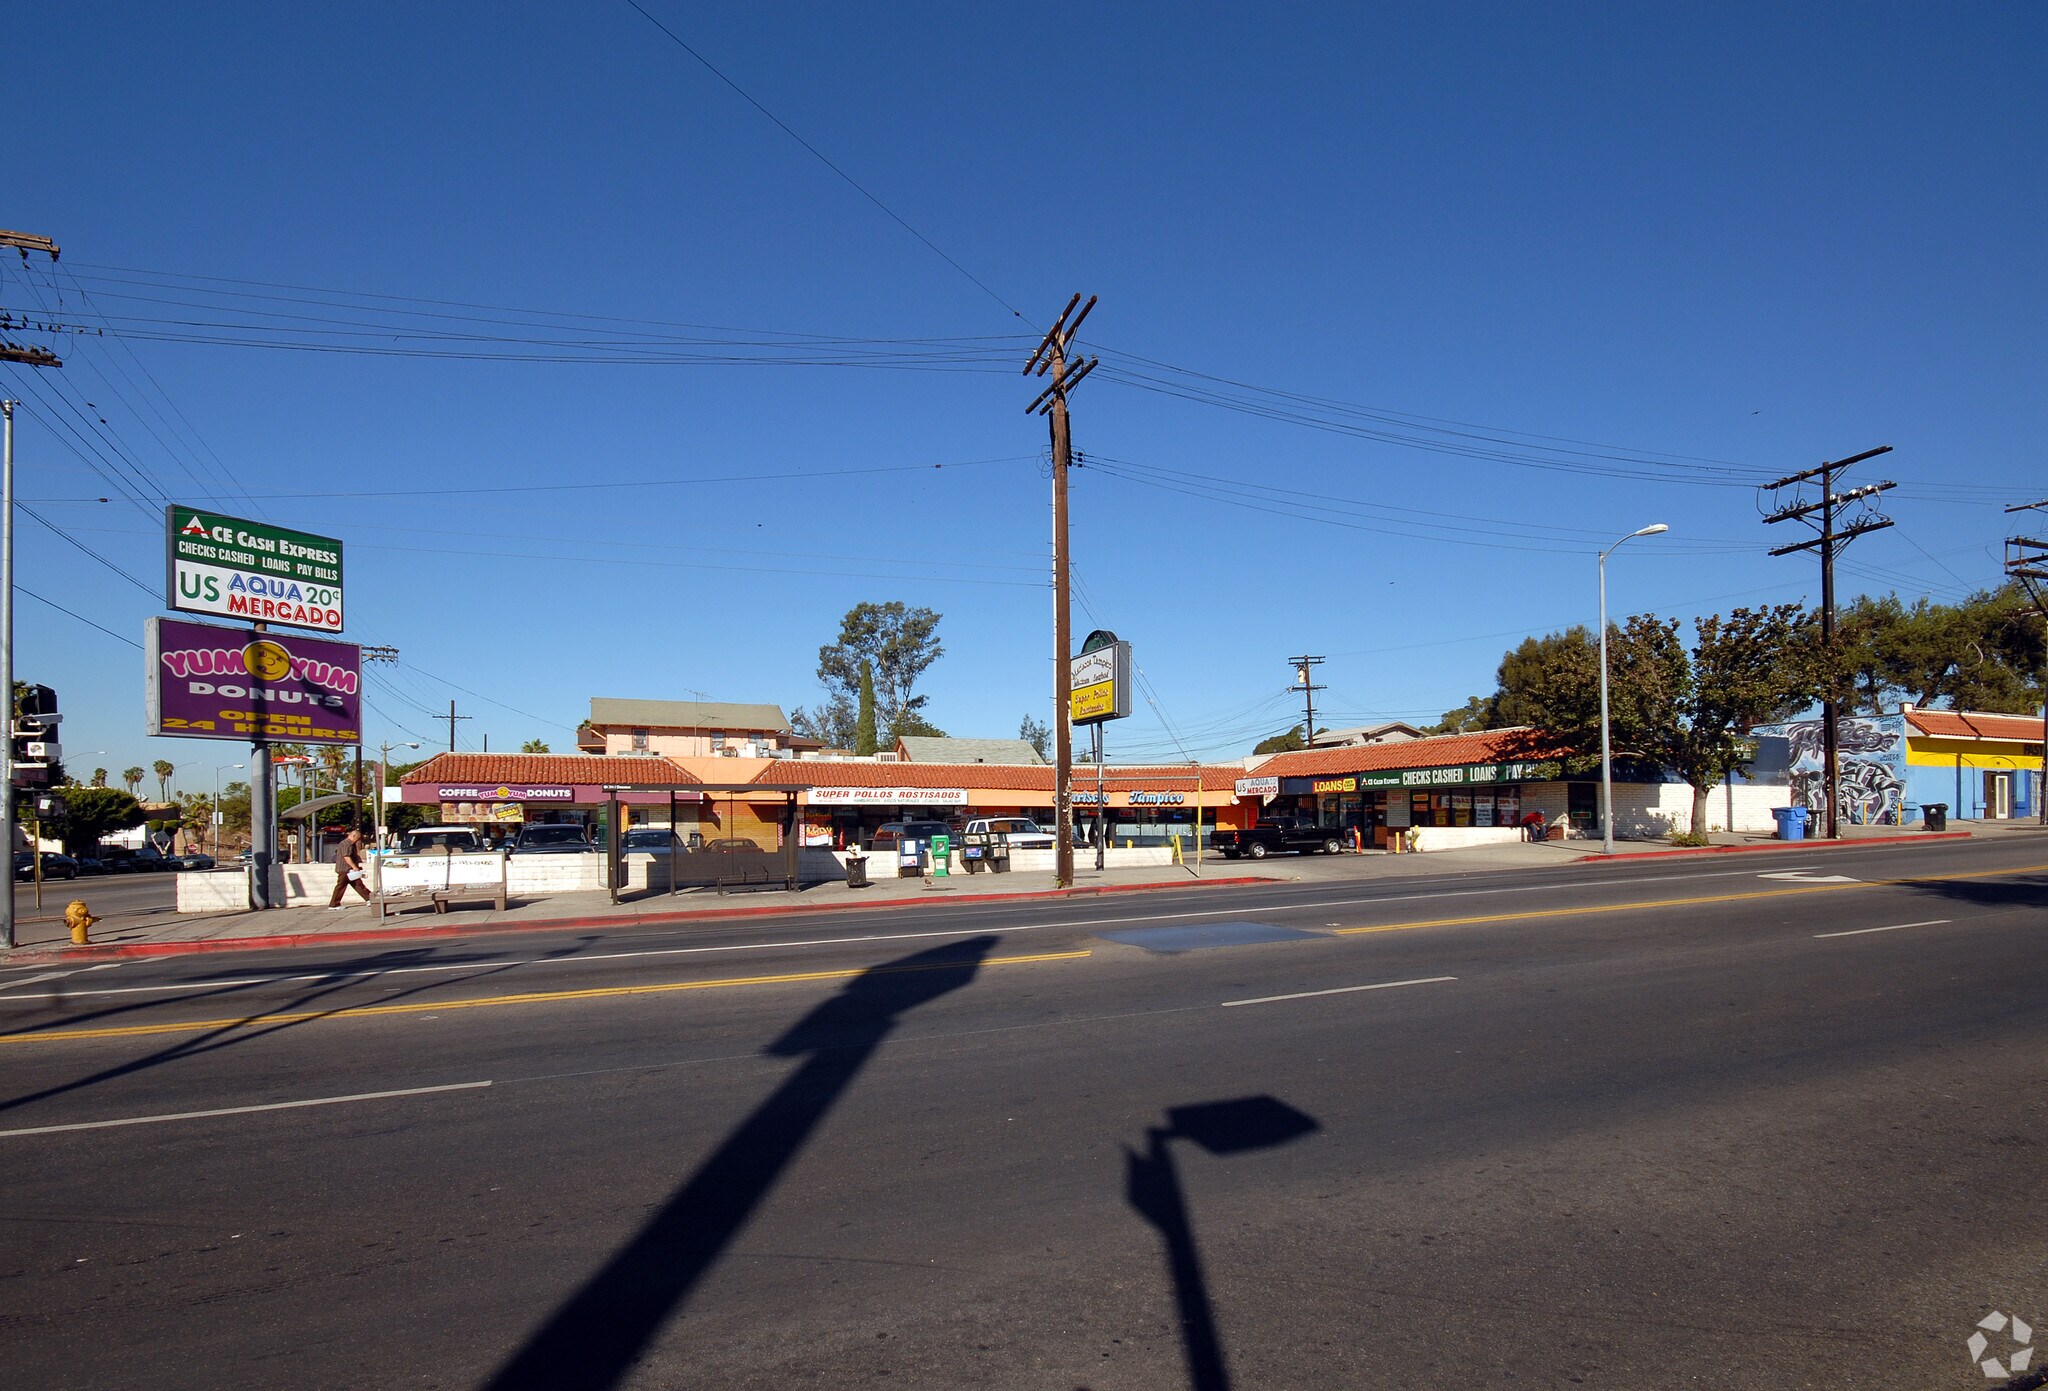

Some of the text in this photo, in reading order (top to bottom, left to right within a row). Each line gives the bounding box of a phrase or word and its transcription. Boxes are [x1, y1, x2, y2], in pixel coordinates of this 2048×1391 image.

[181, 515, 337, 564] ACE CASH EXPRESS
[179, 540, 338, 581] CHECKS CASHED LOANS PAY BILLS
[180, 571, 220, 602] US
[227, 573, 303, 602] AQUA
[227, 594, 341, 627] MERCADO
[161, 649, 358, 694] YUM YUM
[189, 682, 344, 707] DONUTS
[162, 718, 359, 740] 24 HOURS
[218, 710, 311, 726] OPEN
[1236, 783, 1247, 793] US
[1250, 778, 1270, 787] AQUA
[1402, 770, 1431, 786] CHECKS
[1432, 769, 1463, 784] CASHED
[1469, 765, 1497, 782] LOANS
[1506, 764, 1523, 780] PAY
[439, 788, 571, 799] COFFEE YUM YUM DONUTS
[815, 790, 961, 799] SUPER POLLOS ROSTISADOS
[1247, 785, 1278, 794] MERCADO
[1314, 780, 1343, 793] LOANS
[1128, 790, 1184, 806] Tampico
